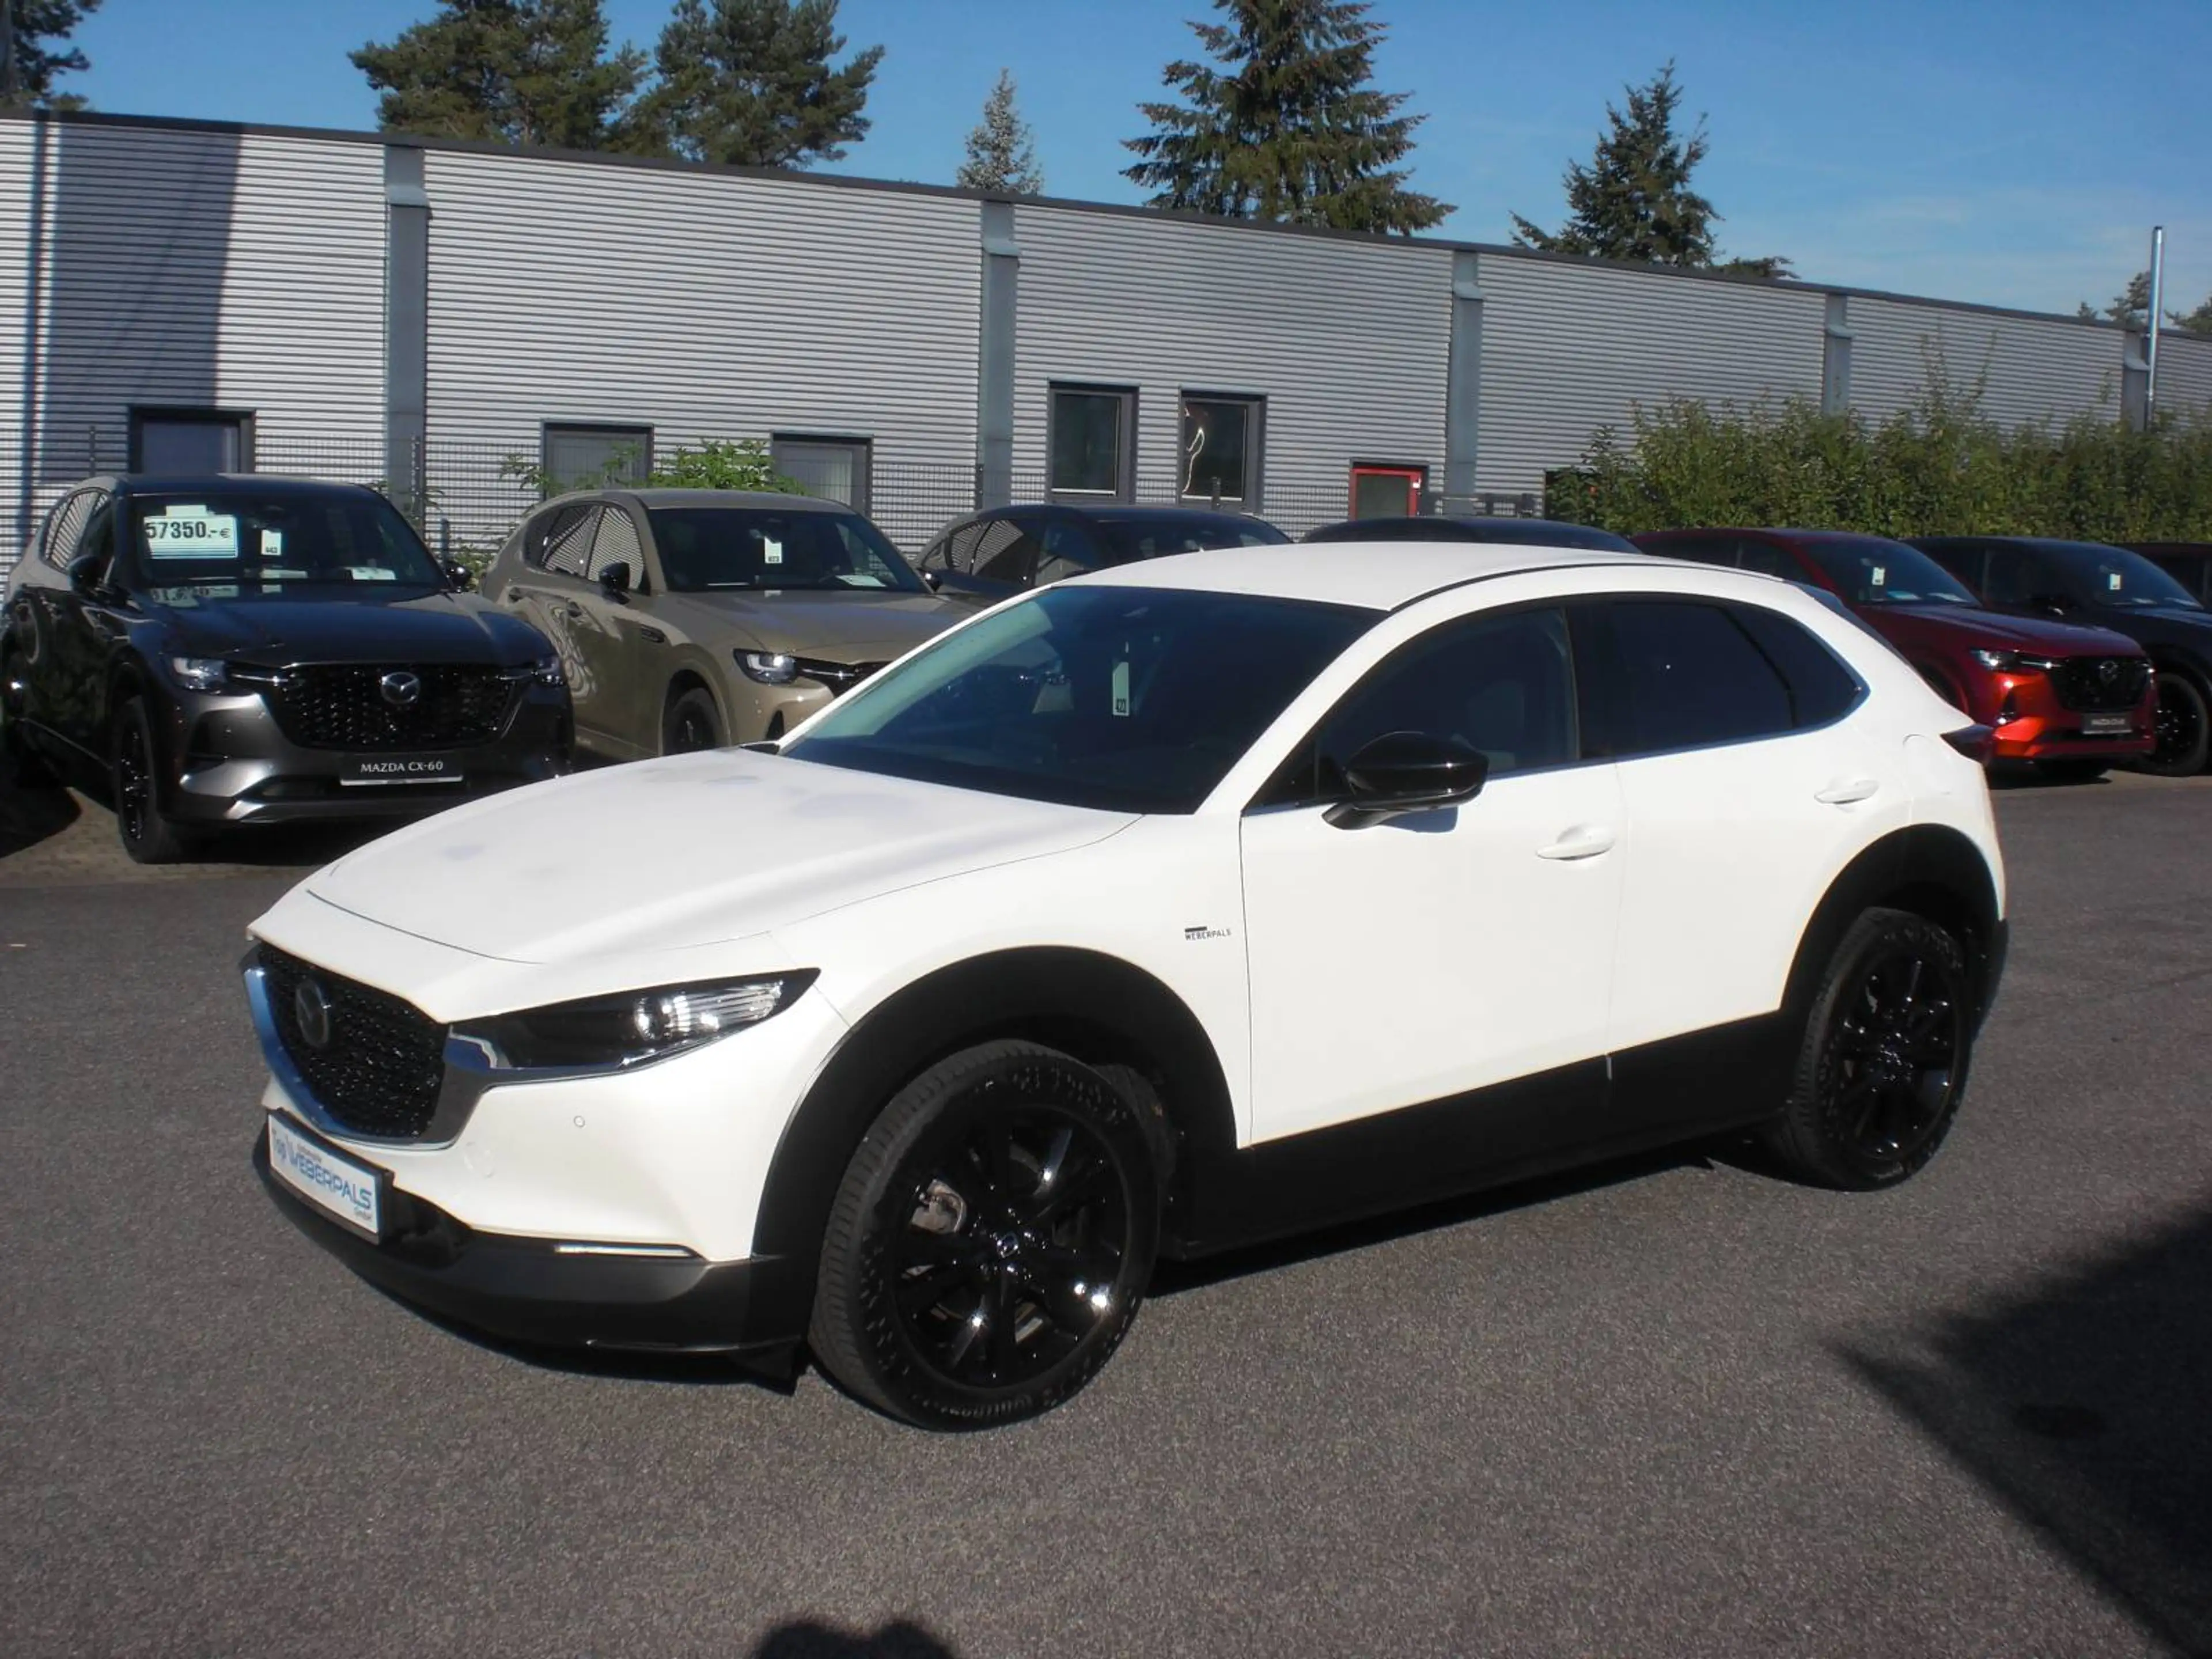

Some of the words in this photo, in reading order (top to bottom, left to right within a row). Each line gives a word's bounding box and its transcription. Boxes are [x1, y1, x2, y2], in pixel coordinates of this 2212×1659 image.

[361, 762, 406, 772] MAZDA
[408, 760, 444, 771] CX-60
[1185, 929, 1232, 941] WEBERPALS
[287, 1138, 372, 1209] WEBERPALS
